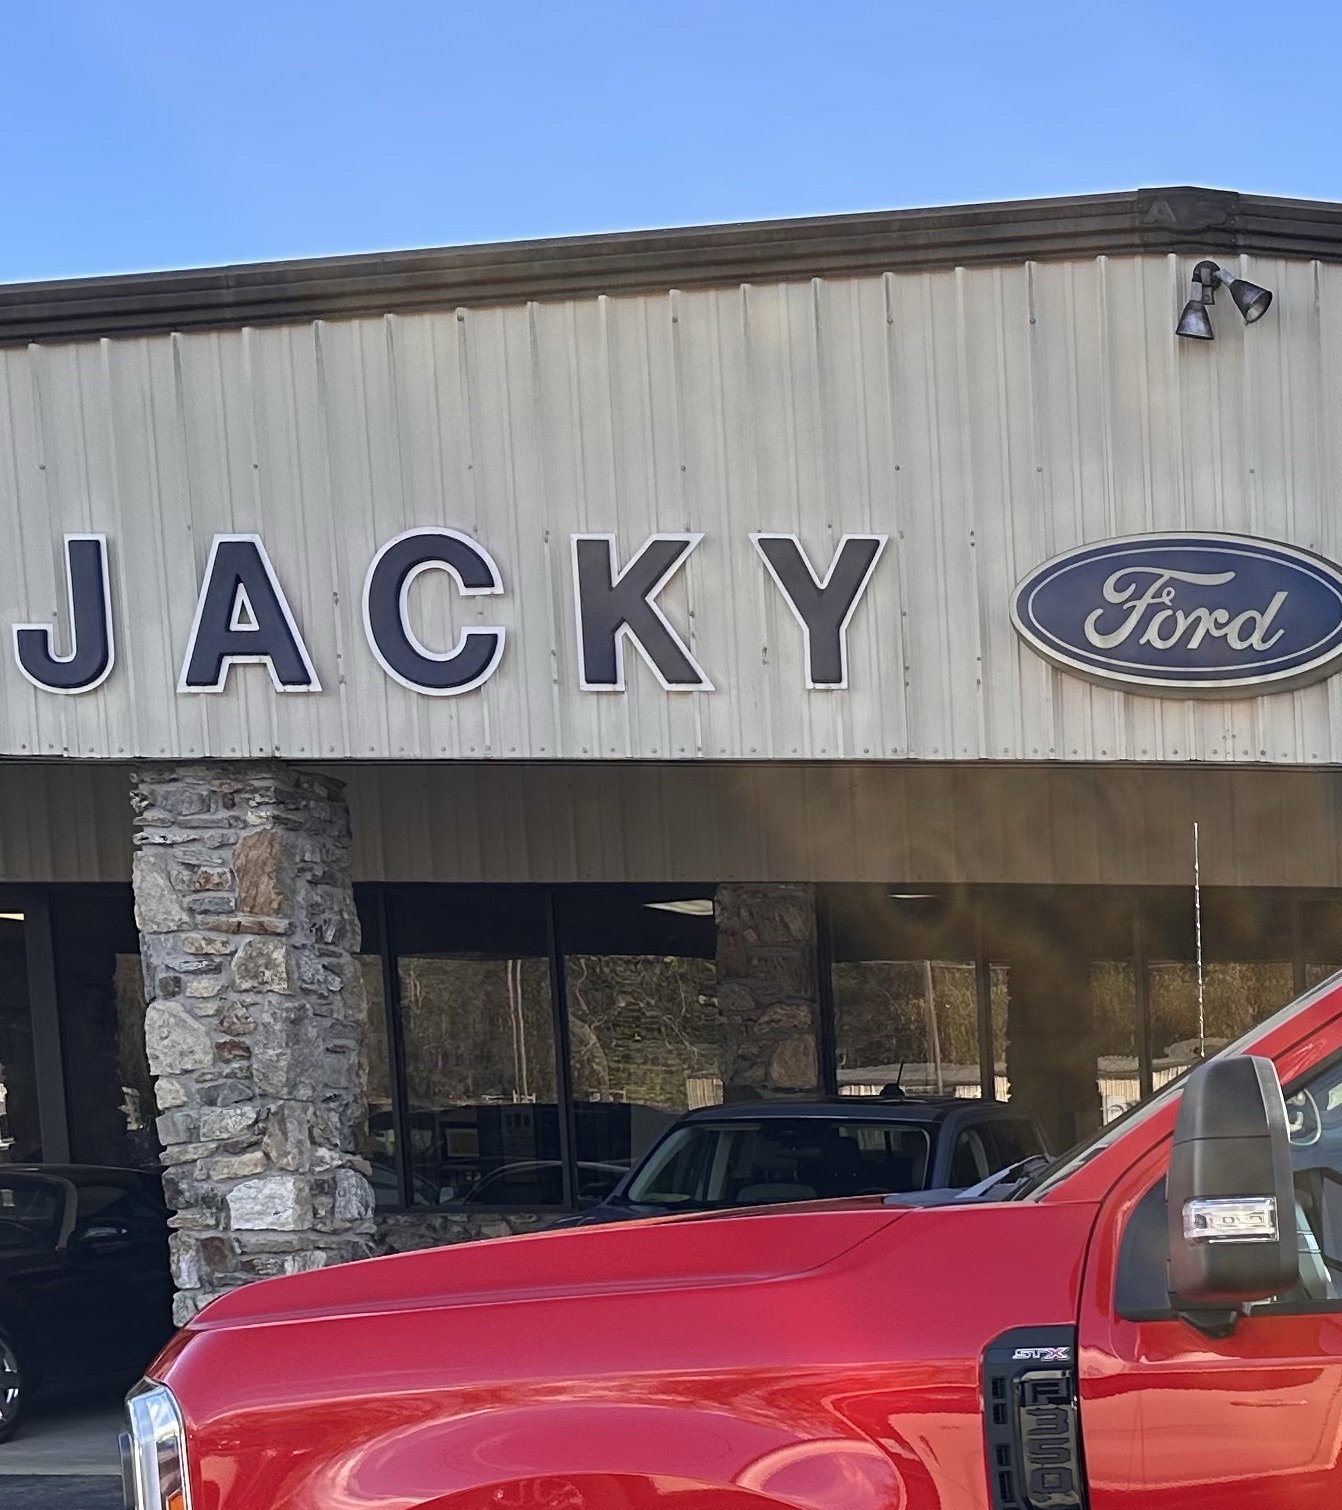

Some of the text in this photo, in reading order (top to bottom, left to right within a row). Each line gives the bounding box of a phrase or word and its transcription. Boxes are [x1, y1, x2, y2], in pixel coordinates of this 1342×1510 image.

[12, 527, 888, 695] JACKY
[1084, 566, 1289, 651] Ford
[1012, 1347, 1071, 1361] STX
